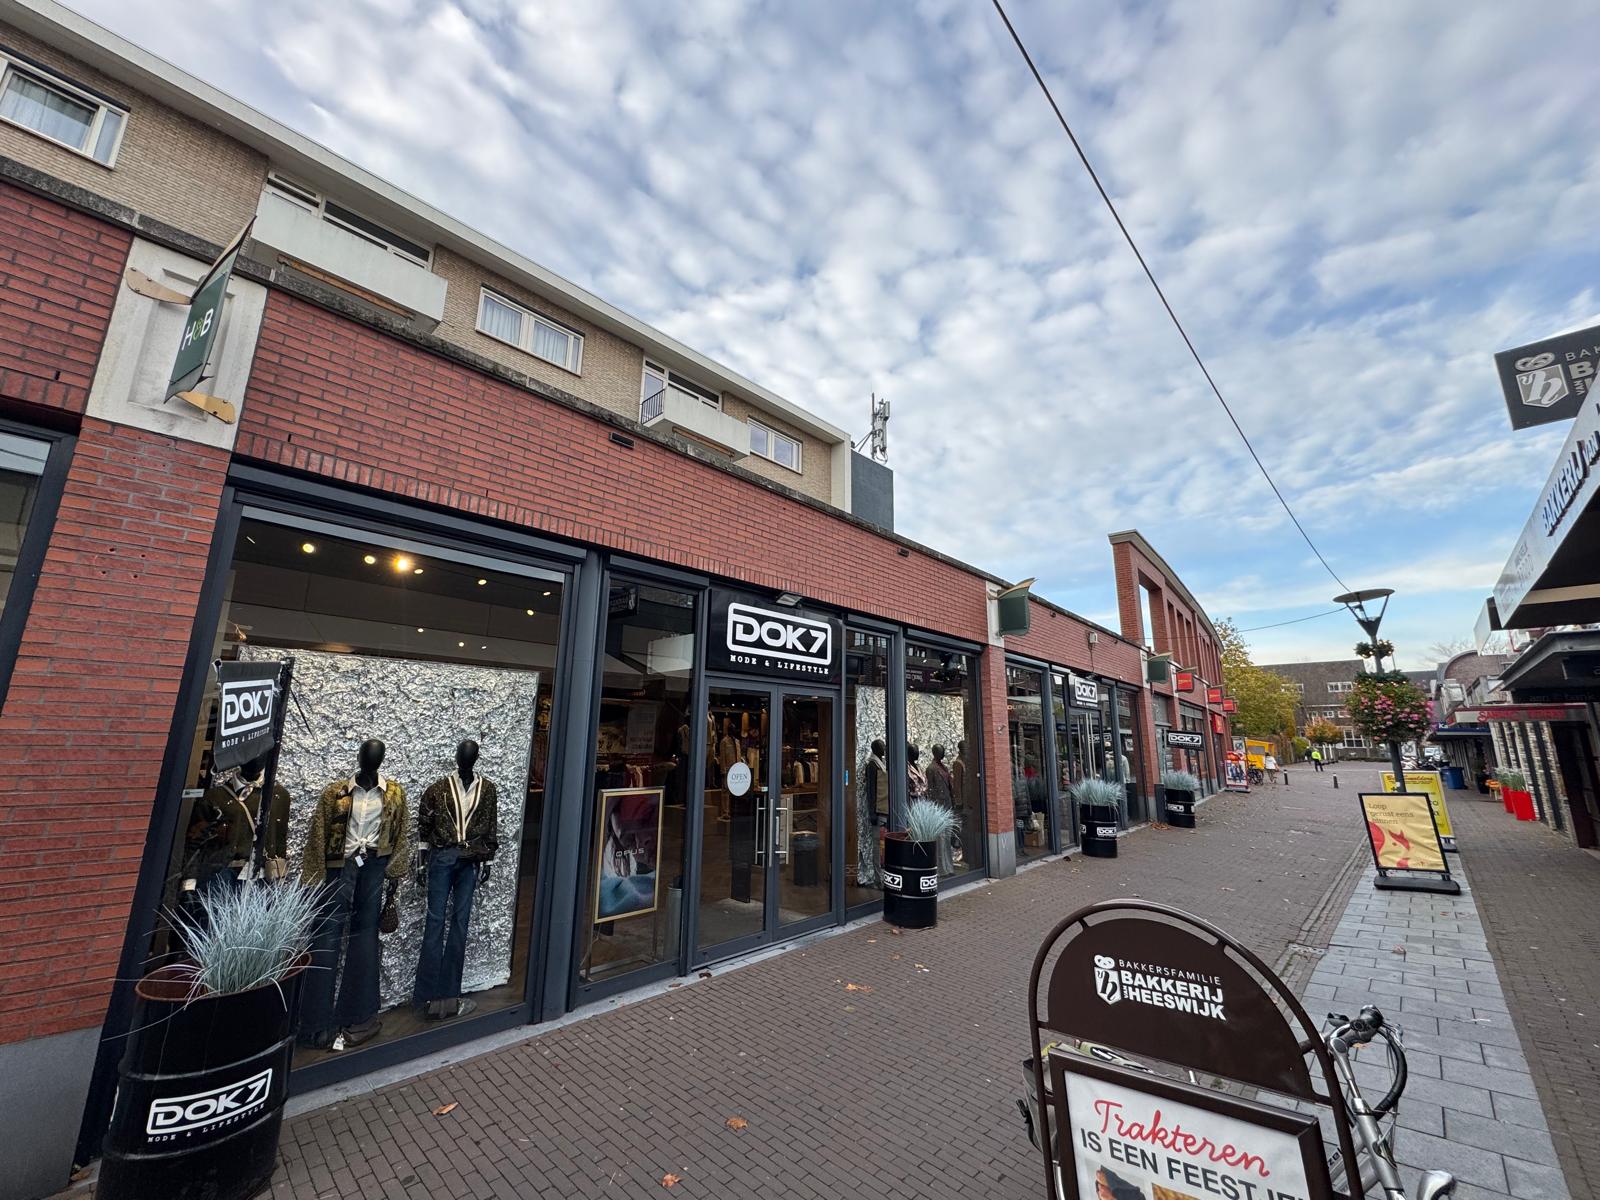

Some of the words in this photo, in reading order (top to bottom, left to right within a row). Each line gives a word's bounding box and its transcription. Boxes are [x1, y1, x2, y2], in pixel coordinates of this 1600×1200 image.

[1568, 361, 1600, 380] B
[729, 612, 829, 655] DOK7
[730, 654, 757, 665] MODE
[777, 661, 829, 675] LIFESTYLE
[224, 689, 273, 723] DOK7
[1170, 734, 1200, 743] DOK7
[615, 847, 645, 858] OPUS
[1119, 959, 1222, 986] BAKKERSFAMILIE
[1120, 969, 1224, 1004] BAKKERIJ
[1128, 986, 1226, 1020] HEESWIJK
[151, 1077, 268, 1127] DOK7
[147, 1133, 177, 1143] MODE
[202, 1102, 266, 1134] LIFESTYLE
[1094, 1099, 1270, 1177] Trakteren
[1080, 1127, 1101, 1153] IS
[1108, 1137, 1158, 1175] EEN
